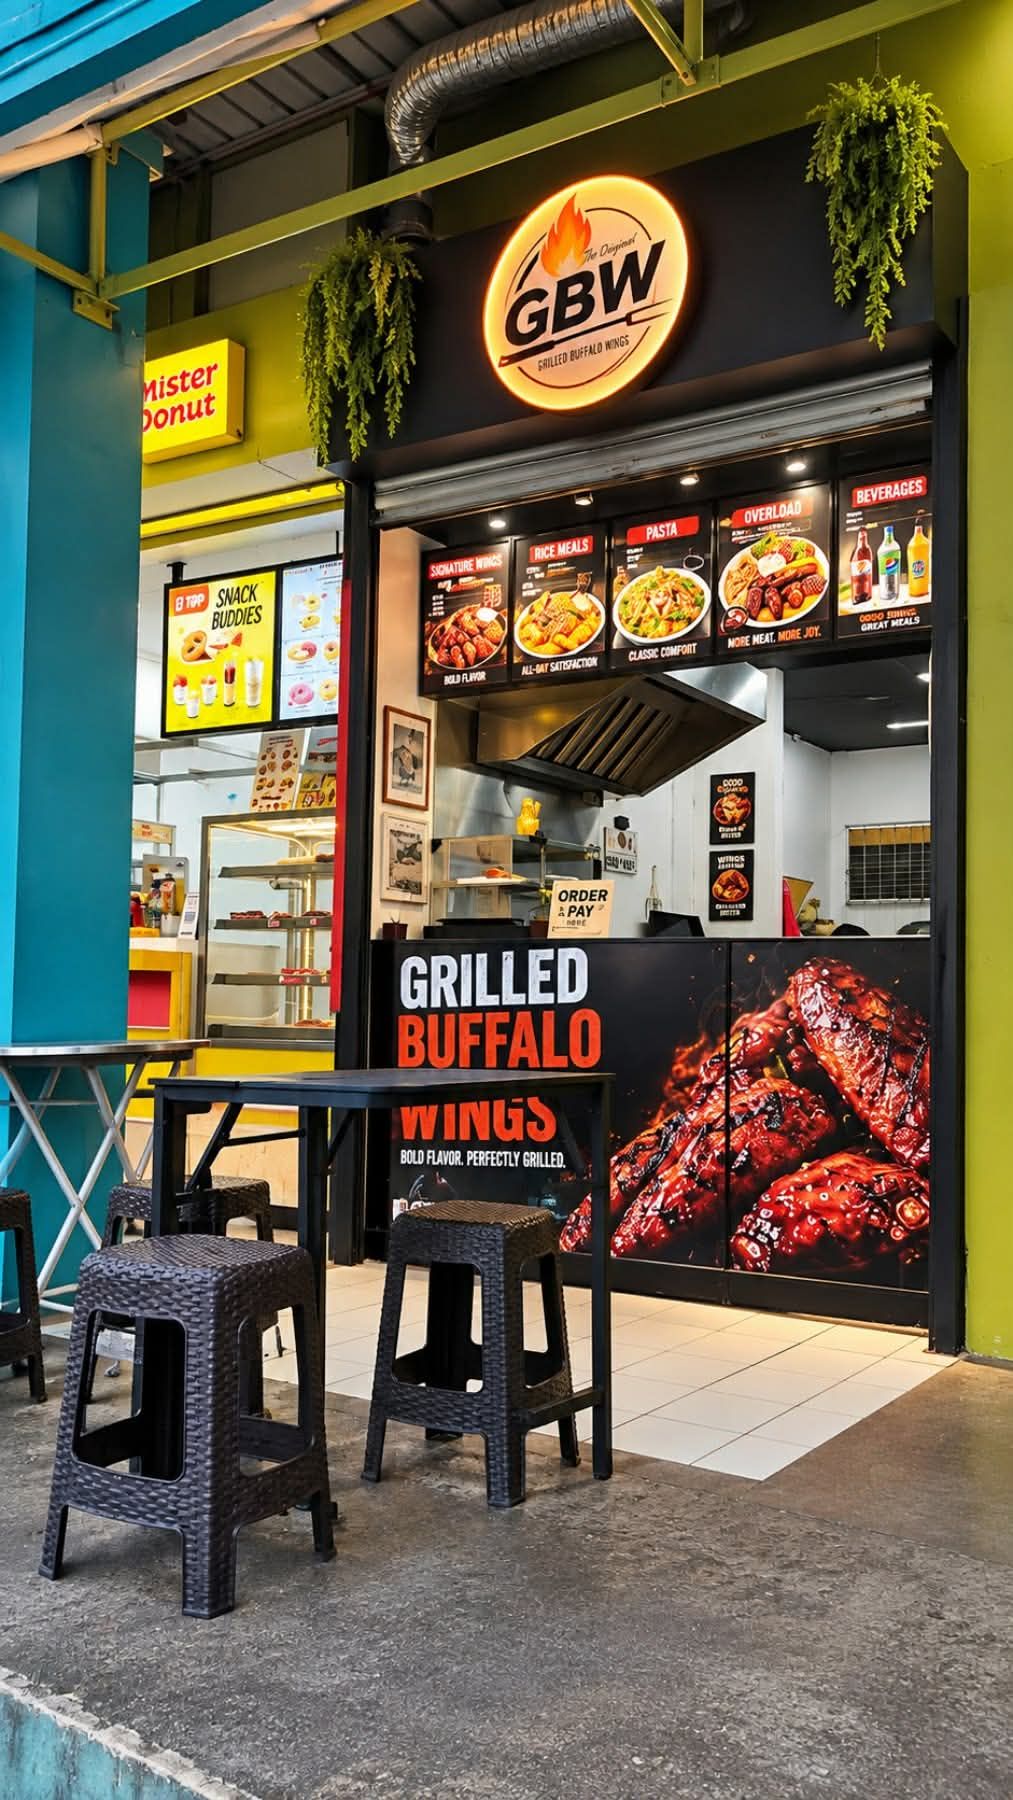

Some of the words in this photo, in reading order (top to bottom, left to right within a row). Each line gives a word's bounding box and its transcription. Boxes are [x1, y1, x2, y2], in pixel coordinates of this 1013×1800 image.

[583, 247, 598, 262] The
[505, 240, 666, 346] GBW
[537, 351, 569, 371] GRILLED
[569, 343, 603, 362] BUFFALO
[604, 334, 630, 352] WINGS
[143, 363, 218, 403] Mister
[856, 479, 923, 504] BEVERAGES
[743, 500, 802, 524] OVERLOAD
[645, 521, 678, 540] PASTA
[534, 545, 556, 561] RICE
[557, 539, 590, 556] MEALS
[430, 557, 474, 577] SIGNATURE
[475, 553, 503, 570] WINGS
[215, 584, 258, 608] SNACK
[211, 605, 263, 630] BUDDIES
[860, 619, 890, 632] GREAT
[890, 616, 921, 628] MEALS
[727, 634, 751, 648] MORE
[751, 631, 776, 646] MEAT.
[777, 628, 802, 642] MORE
[803, 625, 822, 639] JOY.
[628, 646, 660, 662] CLASSIC
[660, 642, 698, 658] COMFORT
[521, 662, 550, 676] ALL-DAY
[549, 656, 599, 673] SATISFACTION
[443, 673, 461, 686] BOLD
[461, 670, 487, 684] FLAVOR
[558, 888, 609, 902] ORDER
[566, 904, 595, 918] PAY
[400, 947, 588, 1010] GRILLED
[397, 1008, 602, 1069] BUFFALO
[400, 1097, 557, 1142] WINGS
[399, 1149, 425, 1165] BOLD
[426, 1149, 464, 1167] FLAVOR.
[466, 1150, 521, 1168] PERFECTLY
[522, 1151, 567, 1169] GRILLED.
